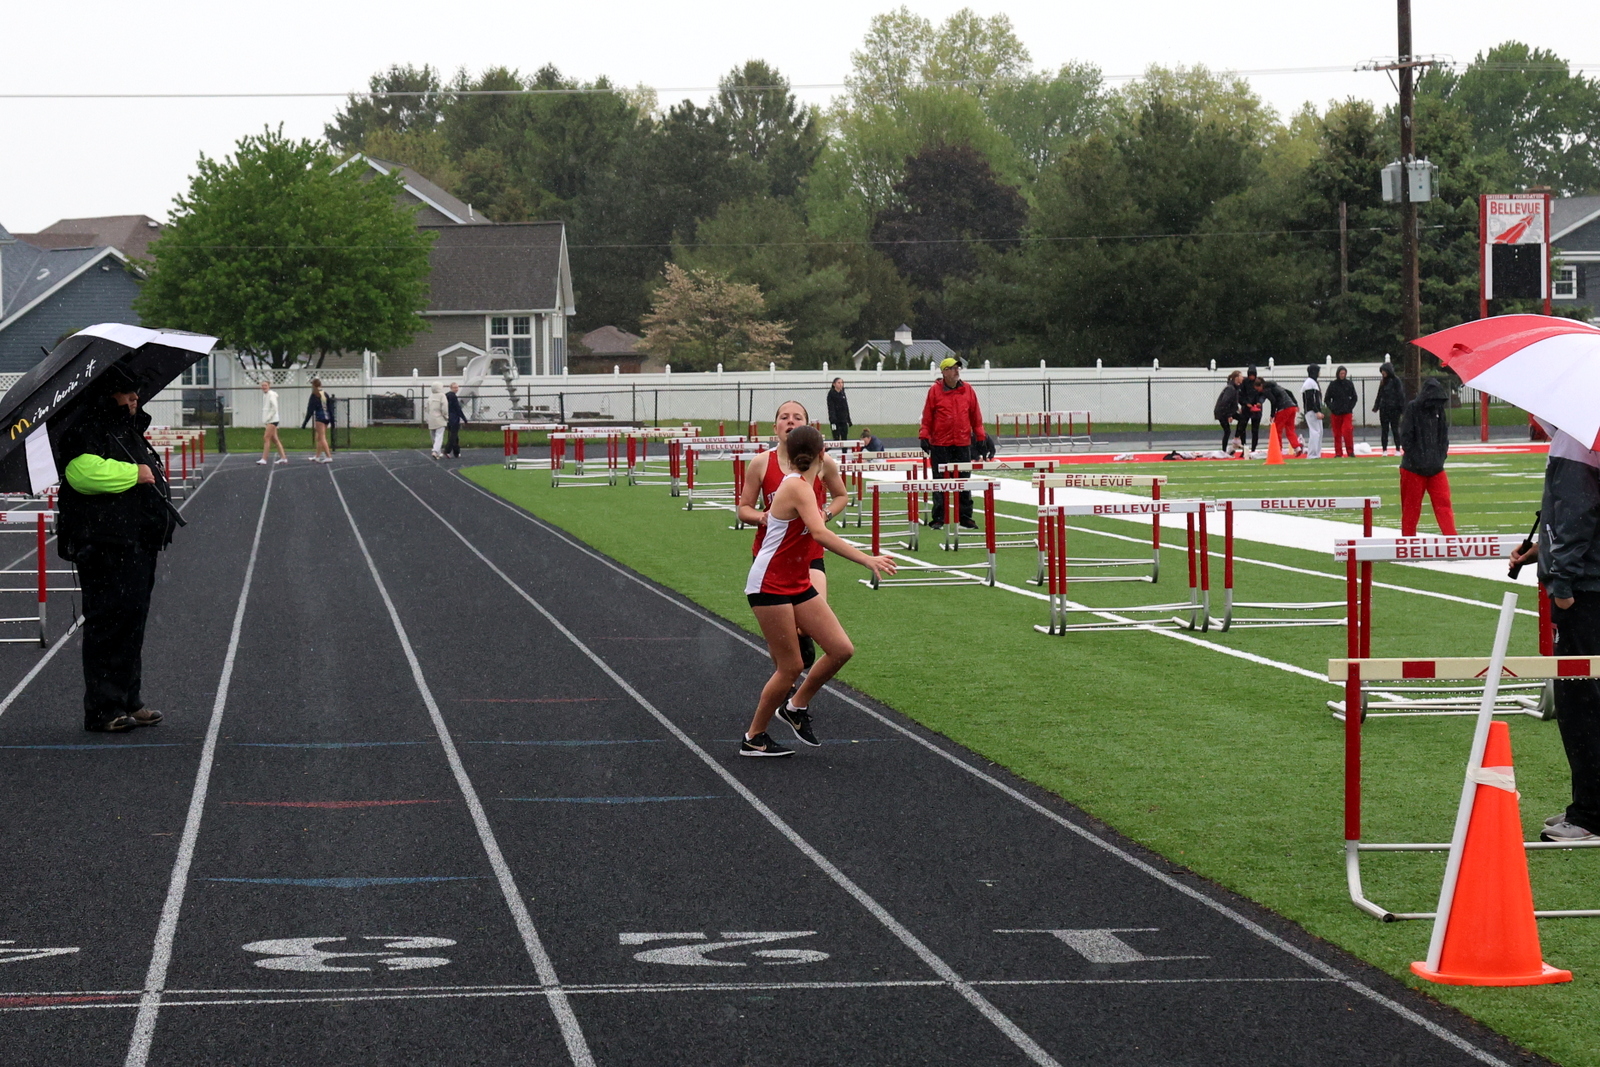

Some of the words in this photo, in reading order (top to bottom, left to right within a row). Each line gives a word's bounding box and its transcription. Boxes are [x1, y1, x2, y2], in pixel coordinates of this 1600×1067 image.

[1490, 201, 1541, 215] BELLEVUE
[902, 483, 965, 491] BELLEVUE
[1065, 478, 1133, 487] BELLEVUE
[1093, 503, 1171, 514] BELLEVUE
[1261, 499, 1337, 508] BELLEVUE
[1396, 545, 1500, 558] BELLEVUE
